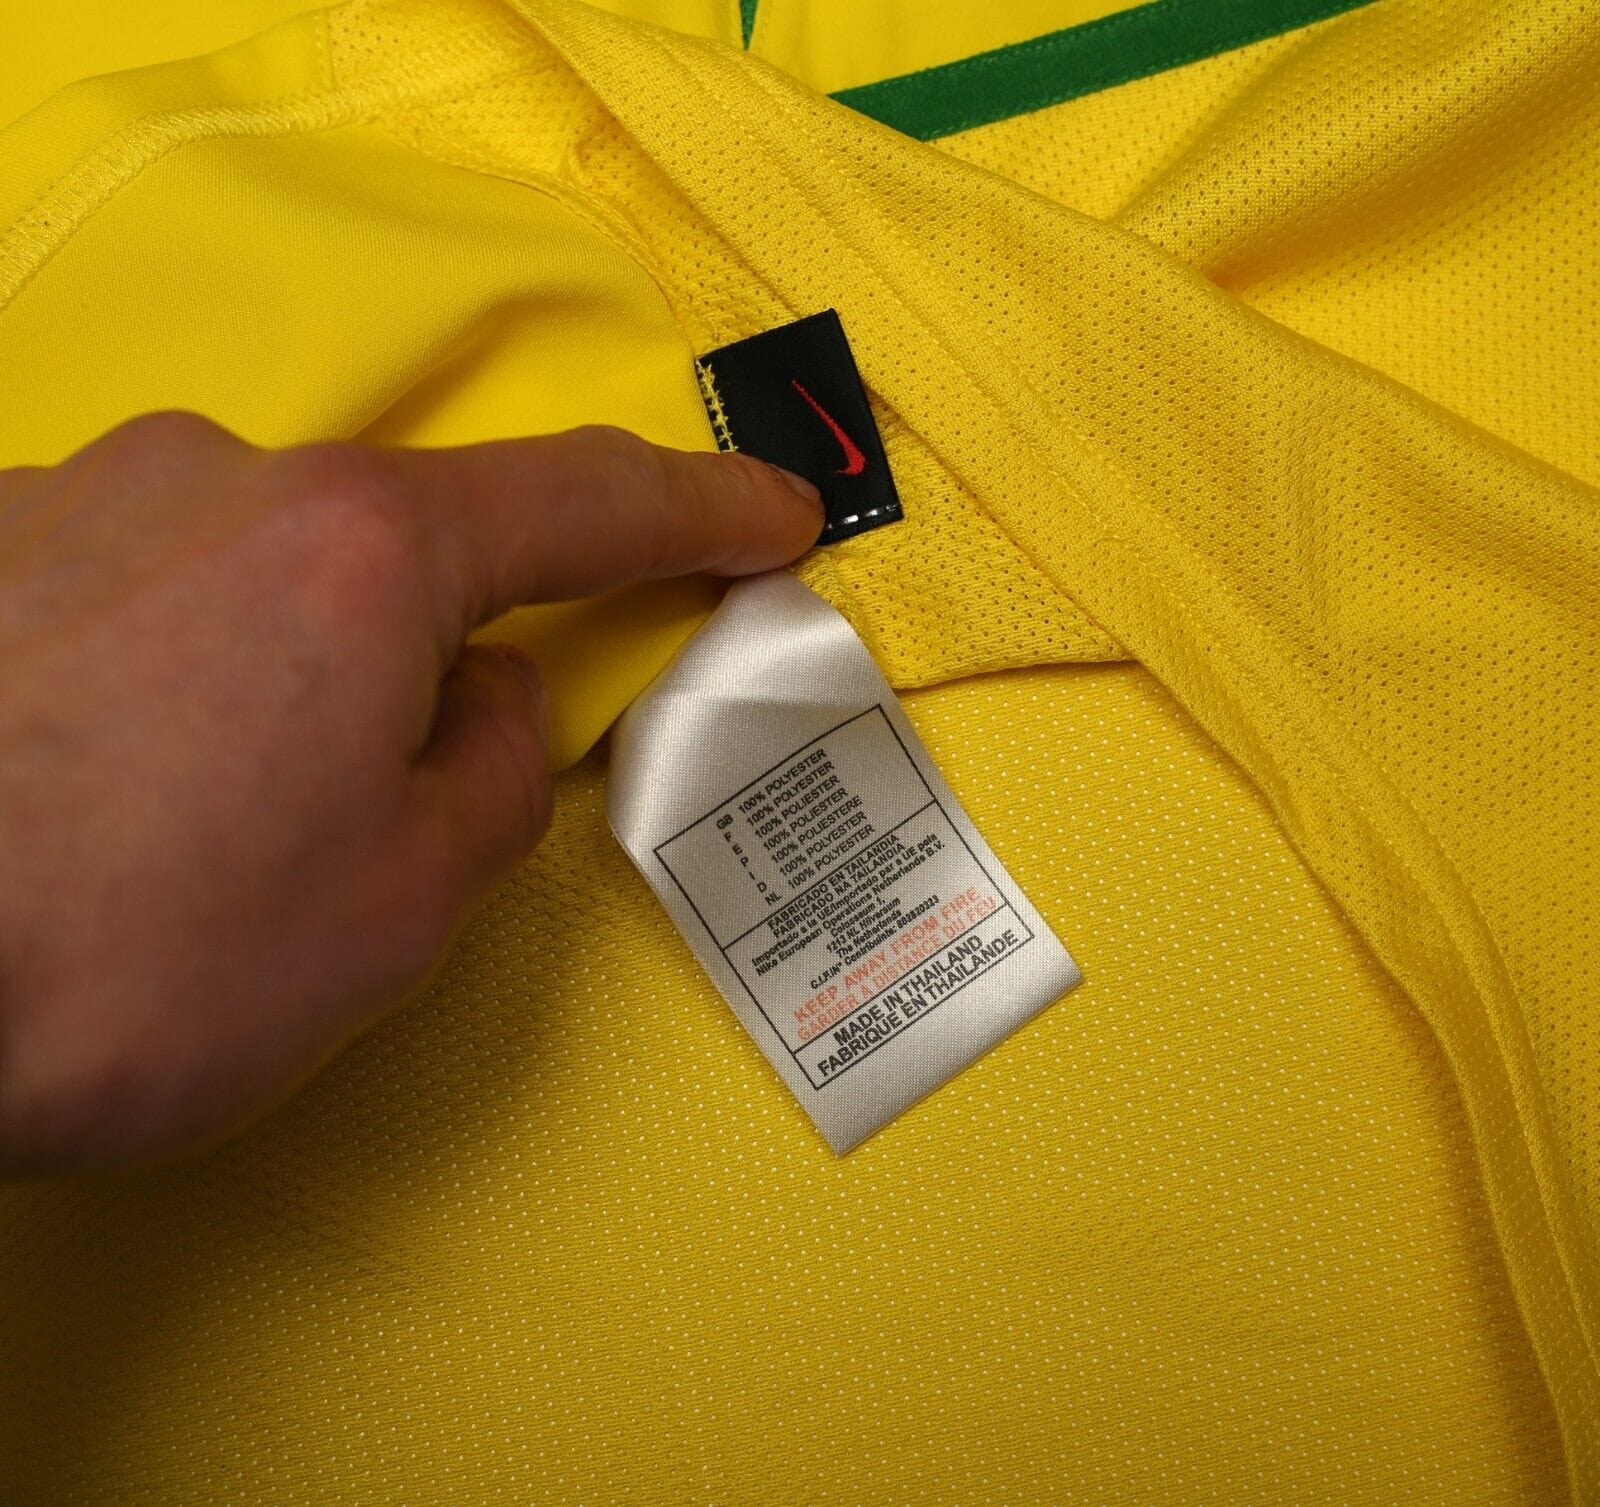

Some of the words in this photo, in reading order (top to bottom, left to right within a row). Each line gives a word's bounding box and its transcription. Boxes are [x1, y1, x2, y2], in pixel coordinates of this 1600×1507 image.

[716, 814, 733, 829] GB
[739, 791, 766, 814] 100%
[765, 749, 827, 795] POLYESTER
[723, 831, 731, 842] F
[747, 804, 774, 826] 100%
[773, 761, 834, 807] POLYESTER
[732, 844, 743, 855] E
[755, 816, 782, 838] 100%
[781, 775, 840, 820] POLIESTER
[740, 857, 748, 867] P
[763, 829, 790, 851] 100%
[789, 788, 848, 833] POLIESTER
[749, 872, 755, 880] I
[771, 841, 798, 863] 100%
[798, 795, 862, 845] POLIESTERE
[757, 882, 767, 893] D
[780, 854, 807, 876] 100%
[806, 811, 867, 858] POLYESTER
[765, 892, 782, 906] NL
[788, 867, 815, 889] 100%
[814, 824, 875, 871] POLYESTER
[752, 932, 799, 968] Importado
[807, 919, 818, 928] la
[902, 846, 917, 860] UE
[756, 958, 778, 976] Nike
[778, 928, 823, 962] European
[822, 893, 872, 930] Operations
[872, 855, 926, 895] Netherlands
[925, 840, 945, 857] B.V.
[767, 883, 828, 930] FABRICADO
[828, 871, 845, 887] EN
[844, 835, 899, 875] TAILANDIA
[773, 893, 833, 938] FABRICADO
[834, 881, 852, 895] NA
[850, 843, 906, 883] TAILANDIA
[793, 985, 840, 1023] KEEP
[841, 951, 888, 989] AWAY
[889, 915, 938, 955] FROM
[939, 887, 978, 920] FIRE
[796, 993, 858, 1042] GARDER
[871, 934, 941, 989] DISTANCE
[942, 918, 965, 939] DU
[965, 896, 996, 922] FEU
[836, 945, 853, 958] The
[853, 910, 902, 947] Netherlands
[846, 927, 860, 939] NL
[818, 1011, 902, 1077] FABRIQUE
[901, 994, 927, 1018] EN
[924, 929, 1018, 1000] THAILANDE
[833, 1005, 885, 1046] MADE
[883, 991, 903, 1011] IN
[900, 935, 982, 996] THAILAND
